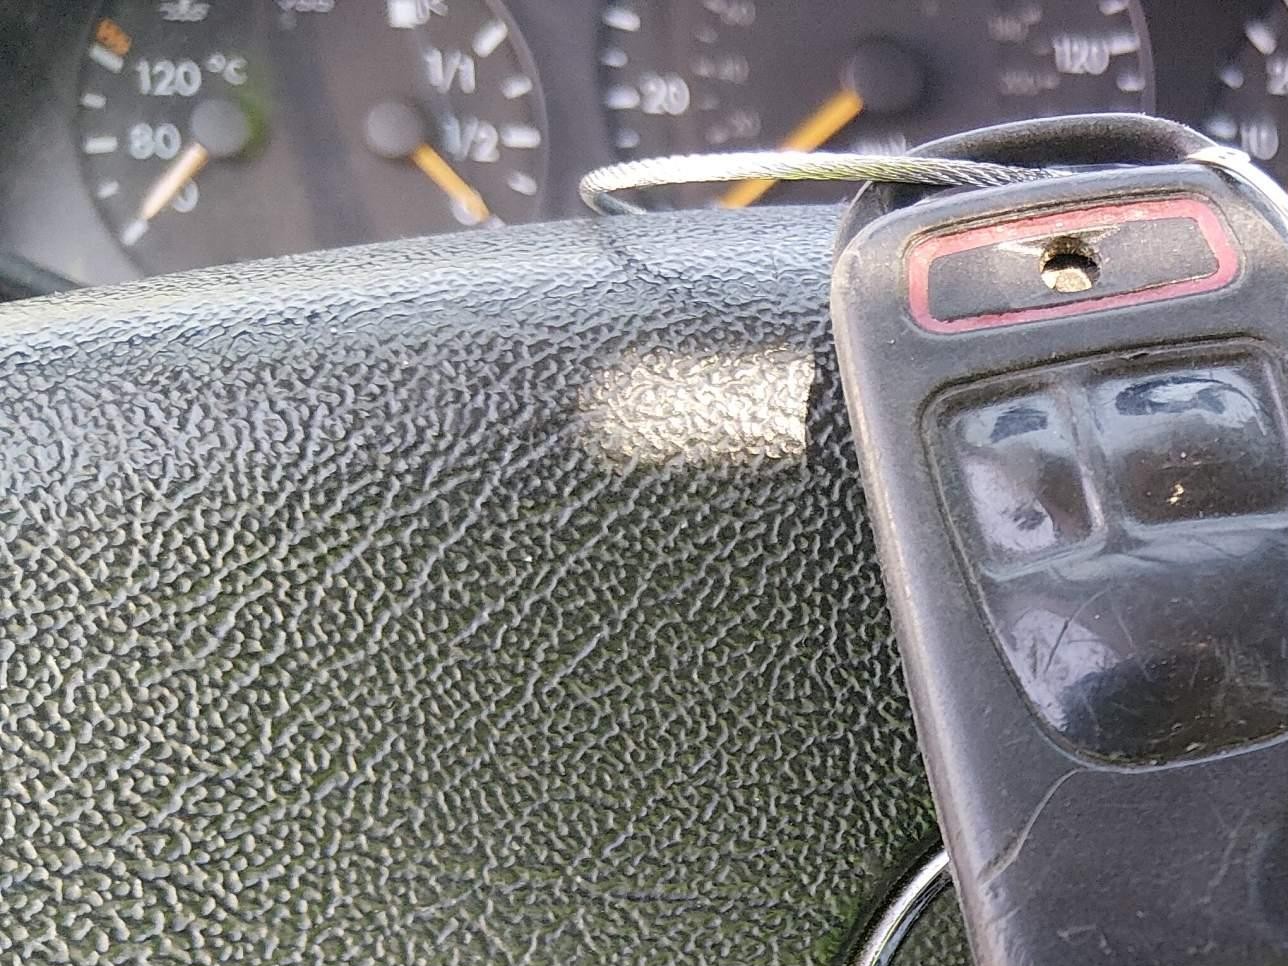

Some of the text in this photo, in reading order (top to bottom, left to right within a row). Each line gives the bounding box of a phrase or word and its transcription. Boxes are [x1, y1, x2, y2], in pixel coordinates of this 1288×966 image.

[136, 57, 202, 97] 120
[640, 71, 690, 115] 20
[129, 123, 182, 160] 80
[440, 112, 500, 163] 1/2
